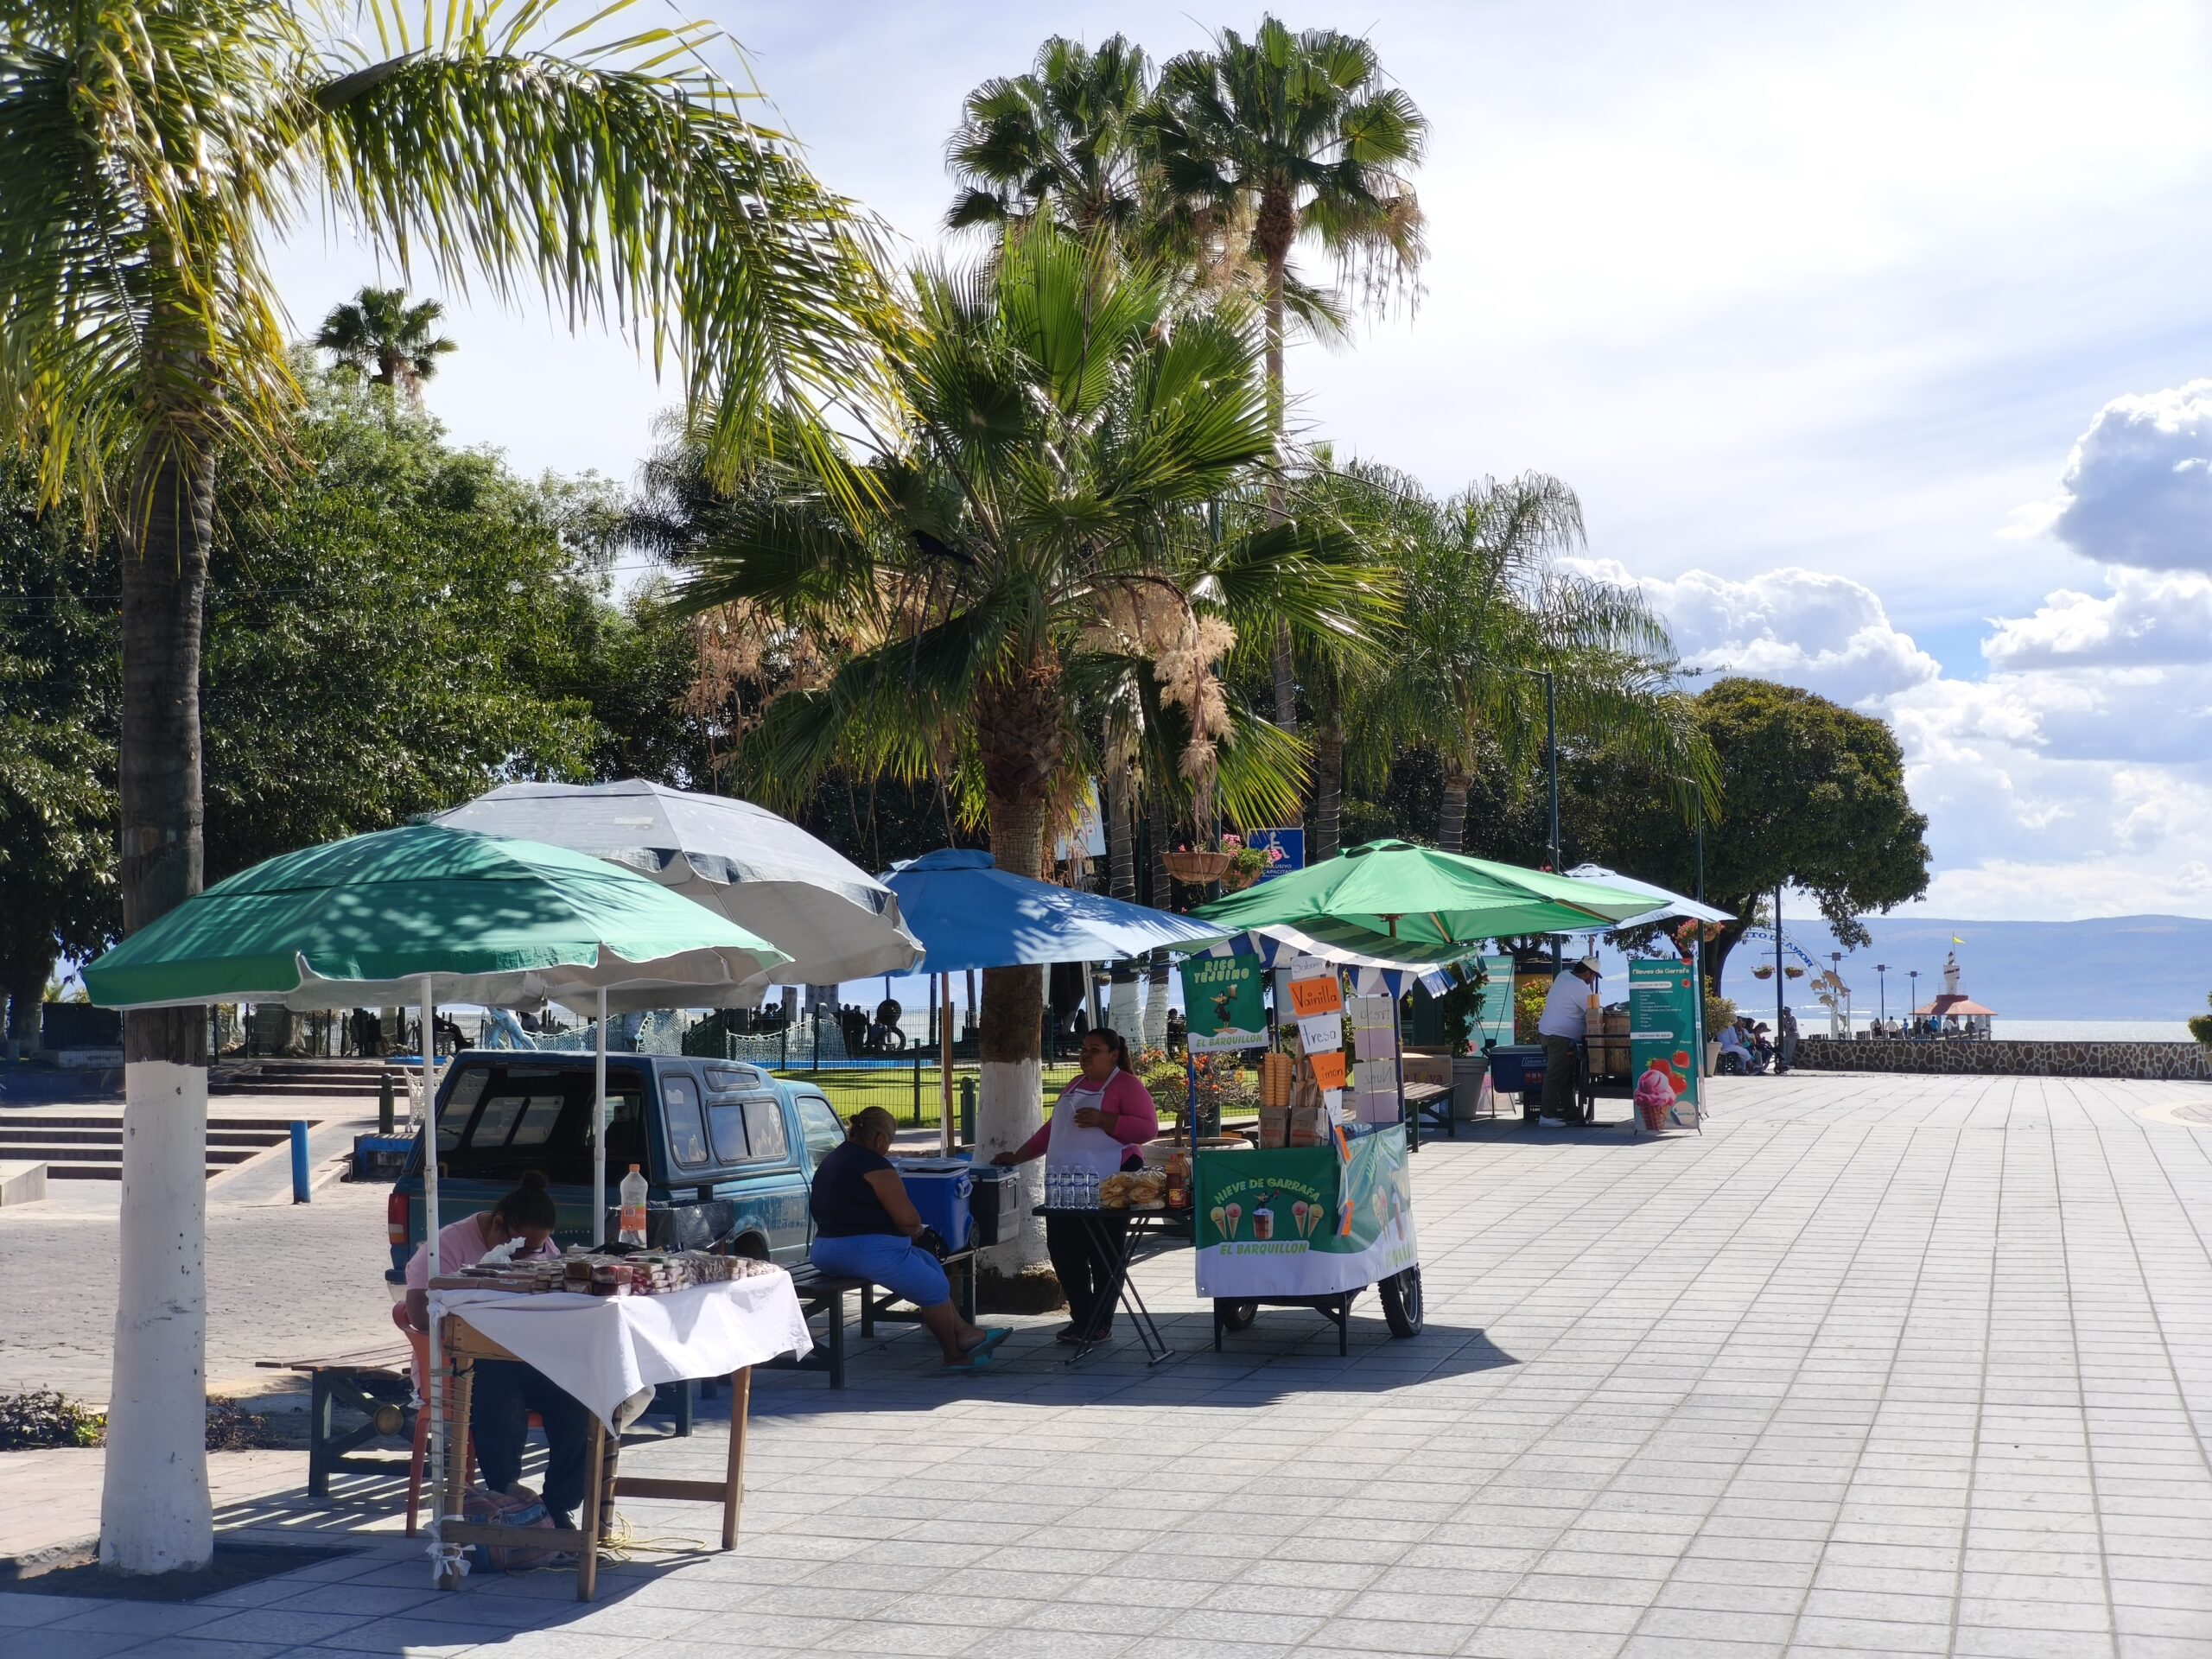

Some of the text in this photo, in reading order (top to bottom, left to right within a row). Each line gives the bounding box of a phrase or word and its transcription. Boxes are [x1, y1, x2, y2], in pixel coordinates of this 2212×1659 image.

[1786, 943, 1814, 968] AMOR
[1205, 959, 1236, 973] RICO
[1194, 968, 1249, 983] TEJUINO
[1291, 985, 1338, 1008] Vainilla
[1196, 1034, 1263, 1048] EL BARQUILLON
[1301, 1024, 1337, 1046] Fresa
[1214, 1177, 1320, 1205] NIEVE DE GARRAFA
[1220, 1243, 1307, 1255] EL BARQUILLON
